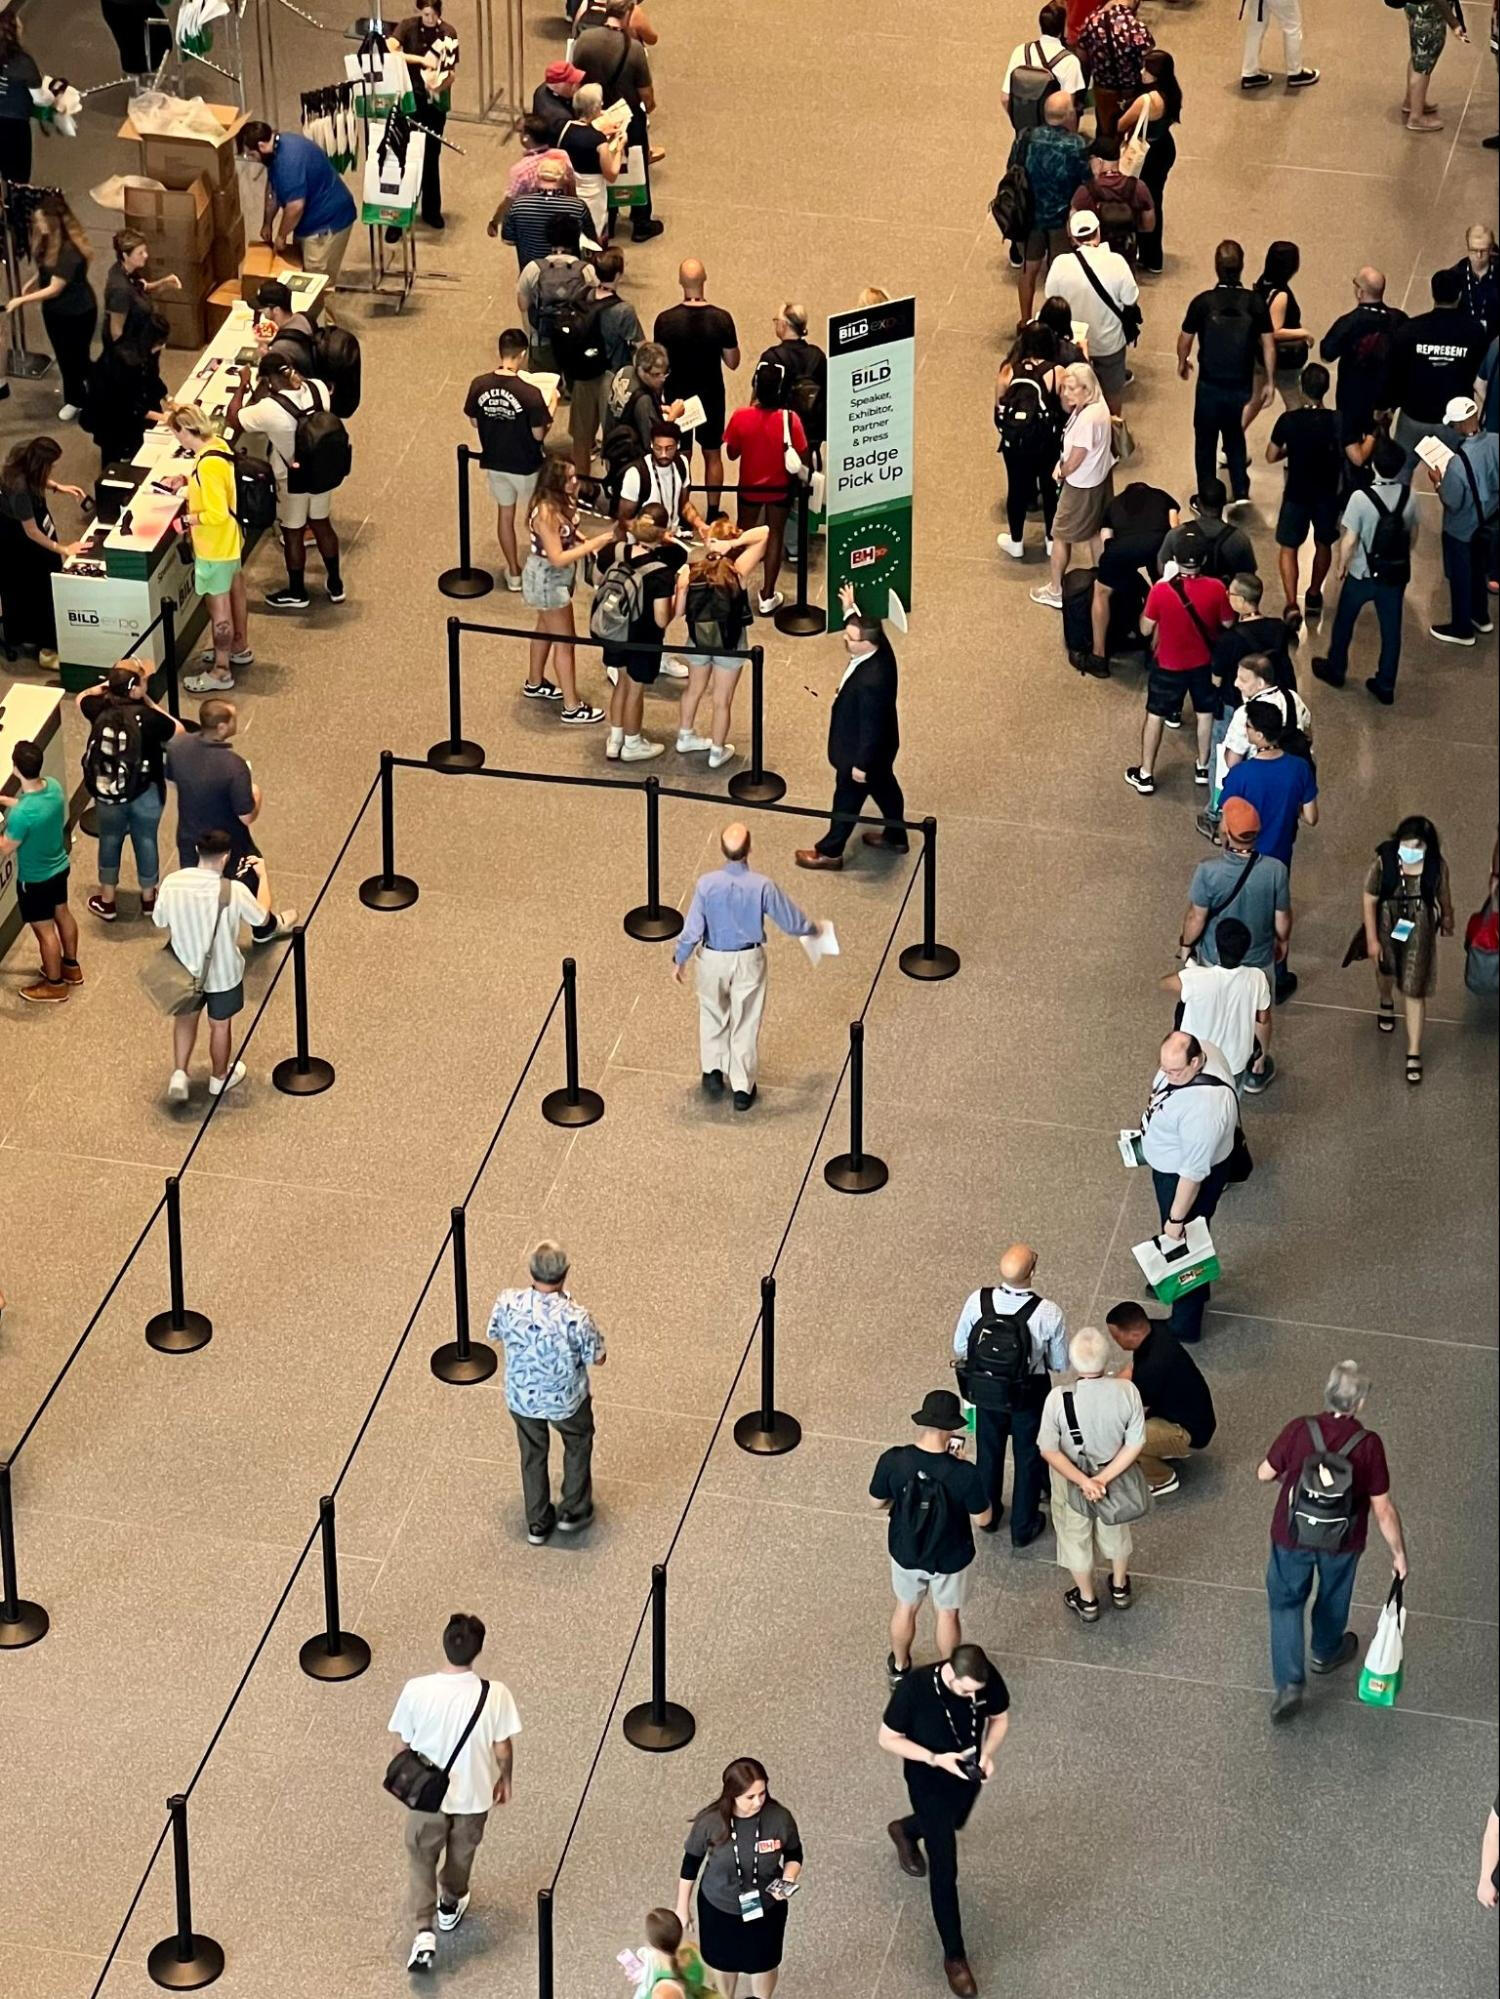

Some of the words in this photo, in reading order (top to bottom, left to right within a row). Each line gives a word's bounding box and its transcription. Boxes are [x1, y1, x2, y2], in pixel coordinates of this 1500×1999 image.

[839, 324, 869, 340] BILD
[1416, 343, 1468, 357] REPRESENT
[852, 367, 891, 387] BILD
[850, 392, 892, 408] Speaker,
[848, 405, 894, 421] Exhibitor,
[852, 419, 889, 434] Partner
[852, 438, 860, 447] &
[862, 432, 889, 444] Press
[843, 448, 899, 471] Badge
[838, 471, 874, 491] Pick
[879, 465, 903, 481] Up
[68, 612, 100, 624] BILD
